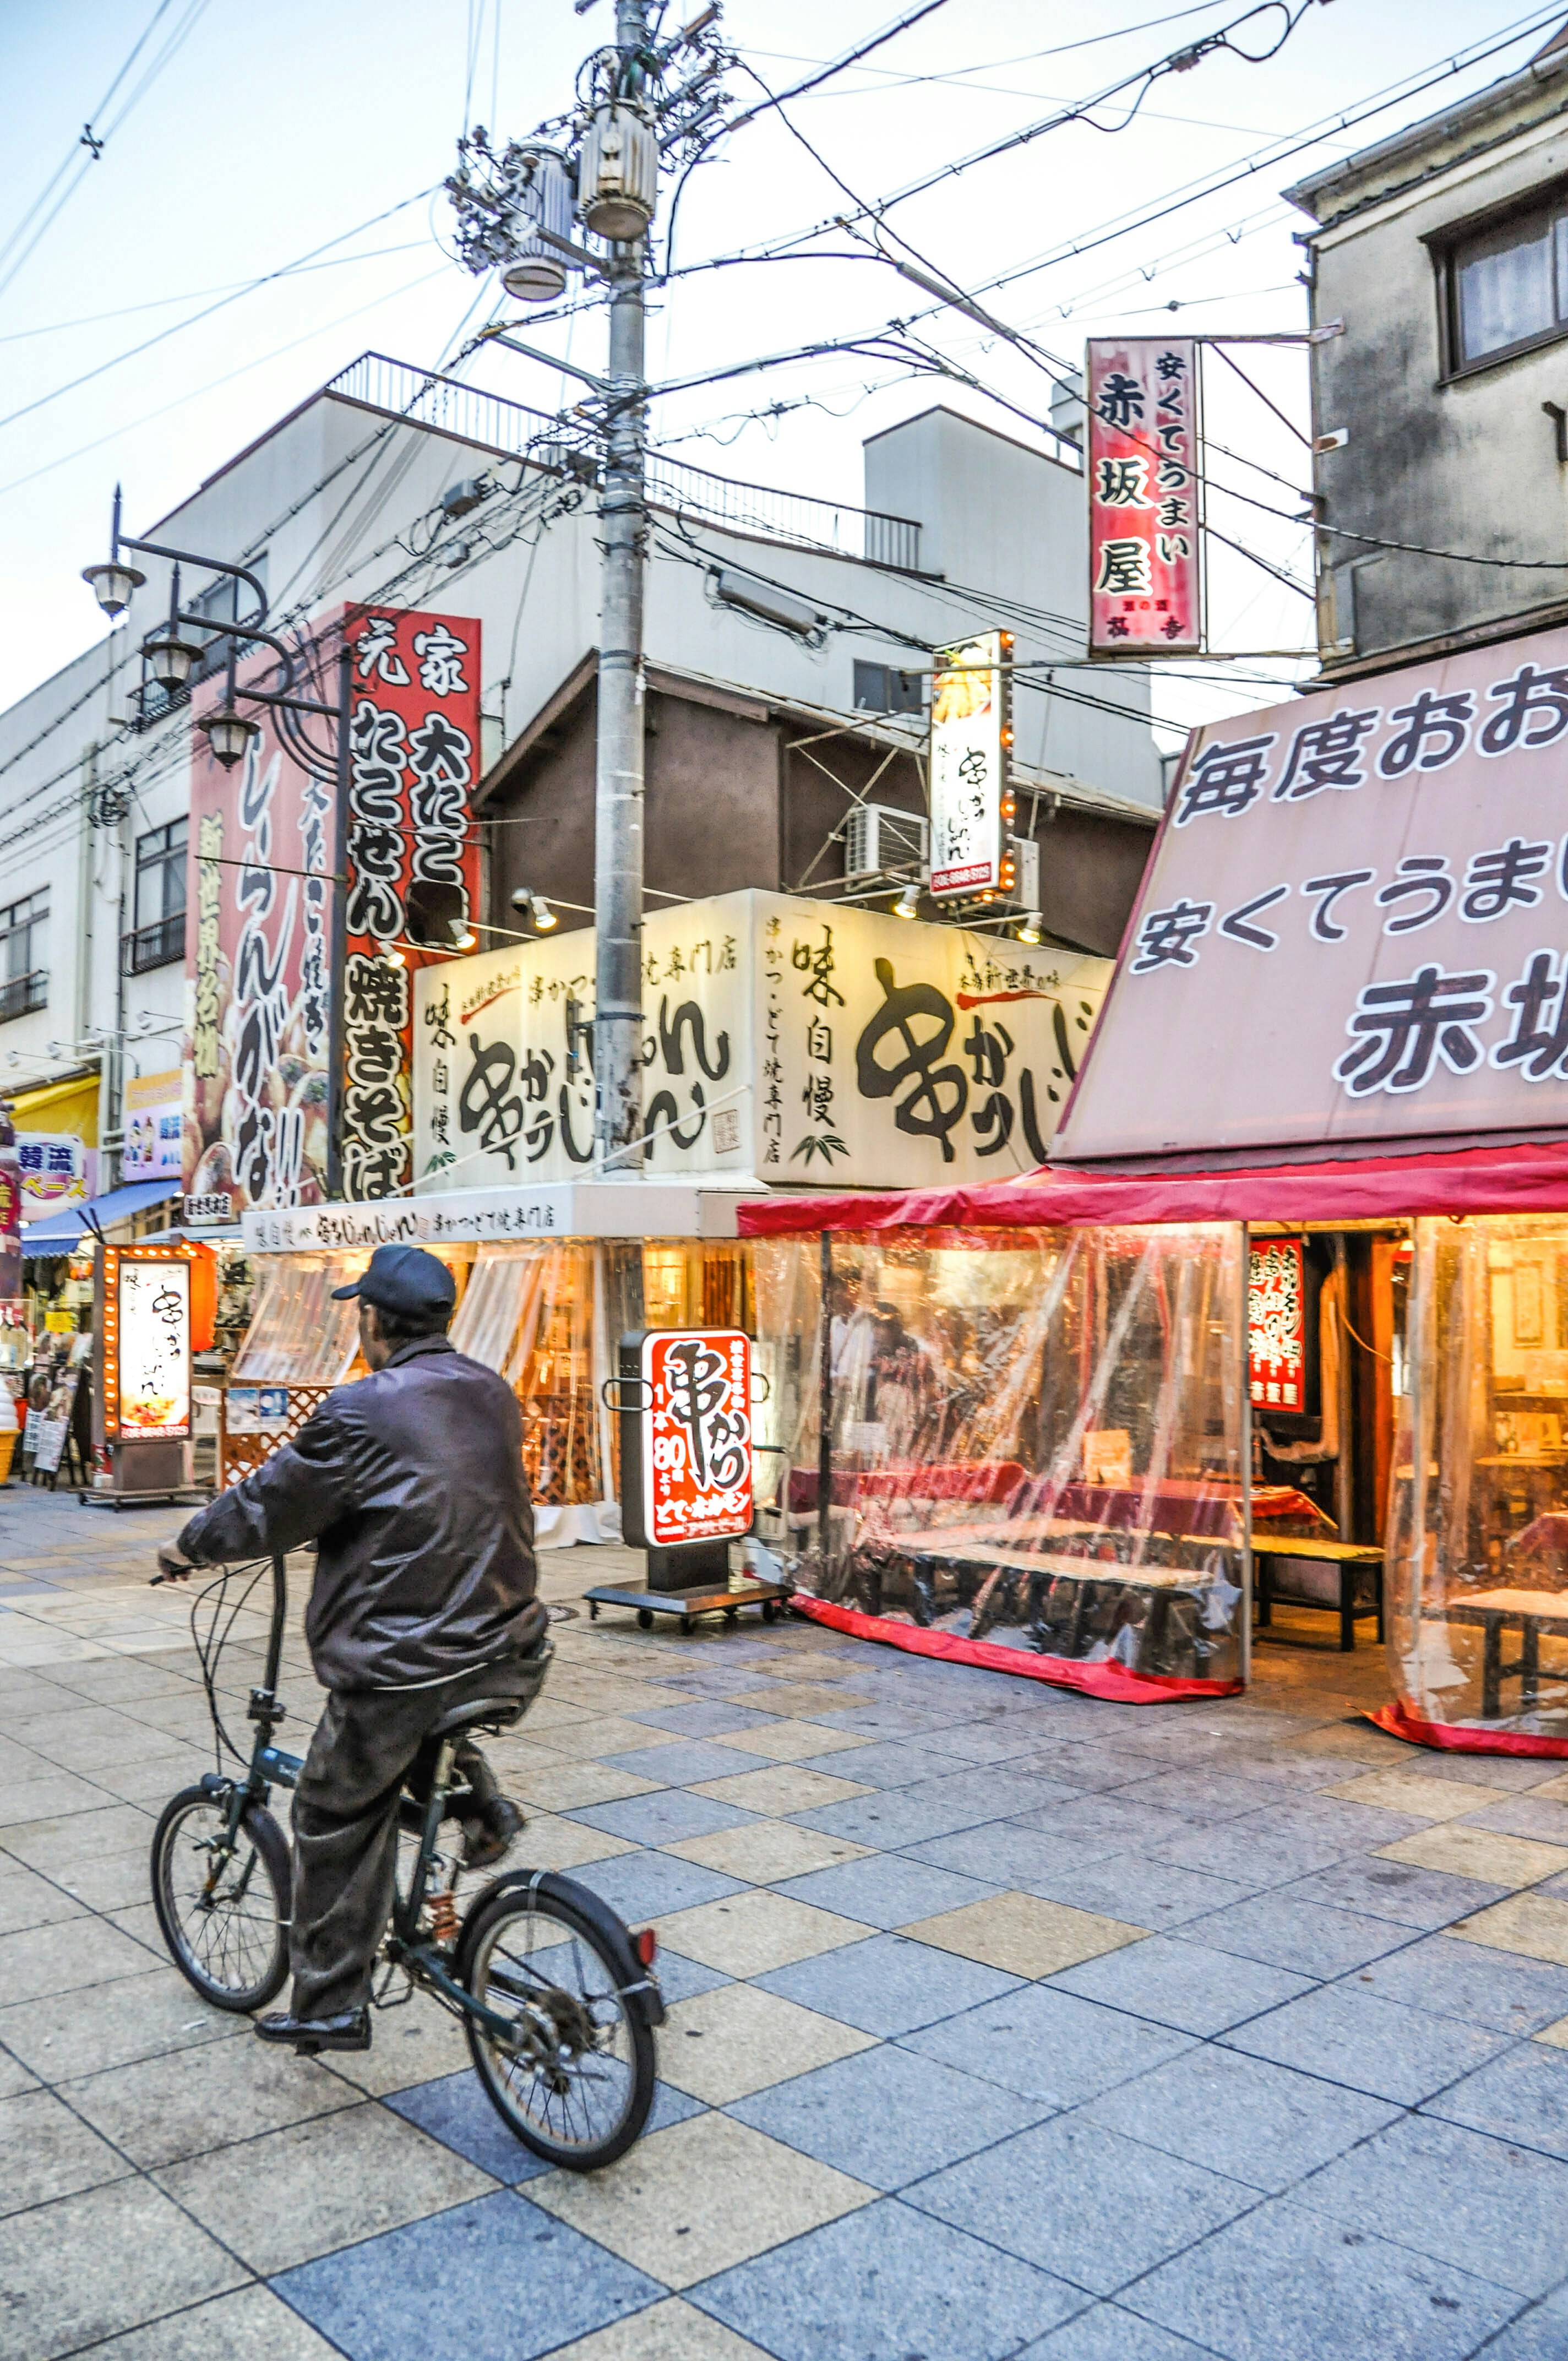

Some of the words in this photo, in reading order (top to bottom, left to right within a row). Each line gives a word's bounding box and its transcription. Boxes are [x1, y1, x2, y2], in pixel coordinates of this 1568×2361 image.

[1096, 373, 1151, 595] 赤坂屋
[1156, 352, 1190, 563] 安くてうまい
[347, 699, 407, 936] たこせん
[408, 711, 471, 948] 大たこ
[1130, 836, 1568, 975] 安くてうま
[344, 953, 409, 1202] 焼きそば
[424, 982, 456, 1146] 味自慢
[763, 915, 783, 1164] 串かつ・どて焼専門店
[791, 923, 845, 1128] 味自慢
[662, 1340, 749, 1492] 串かつ
